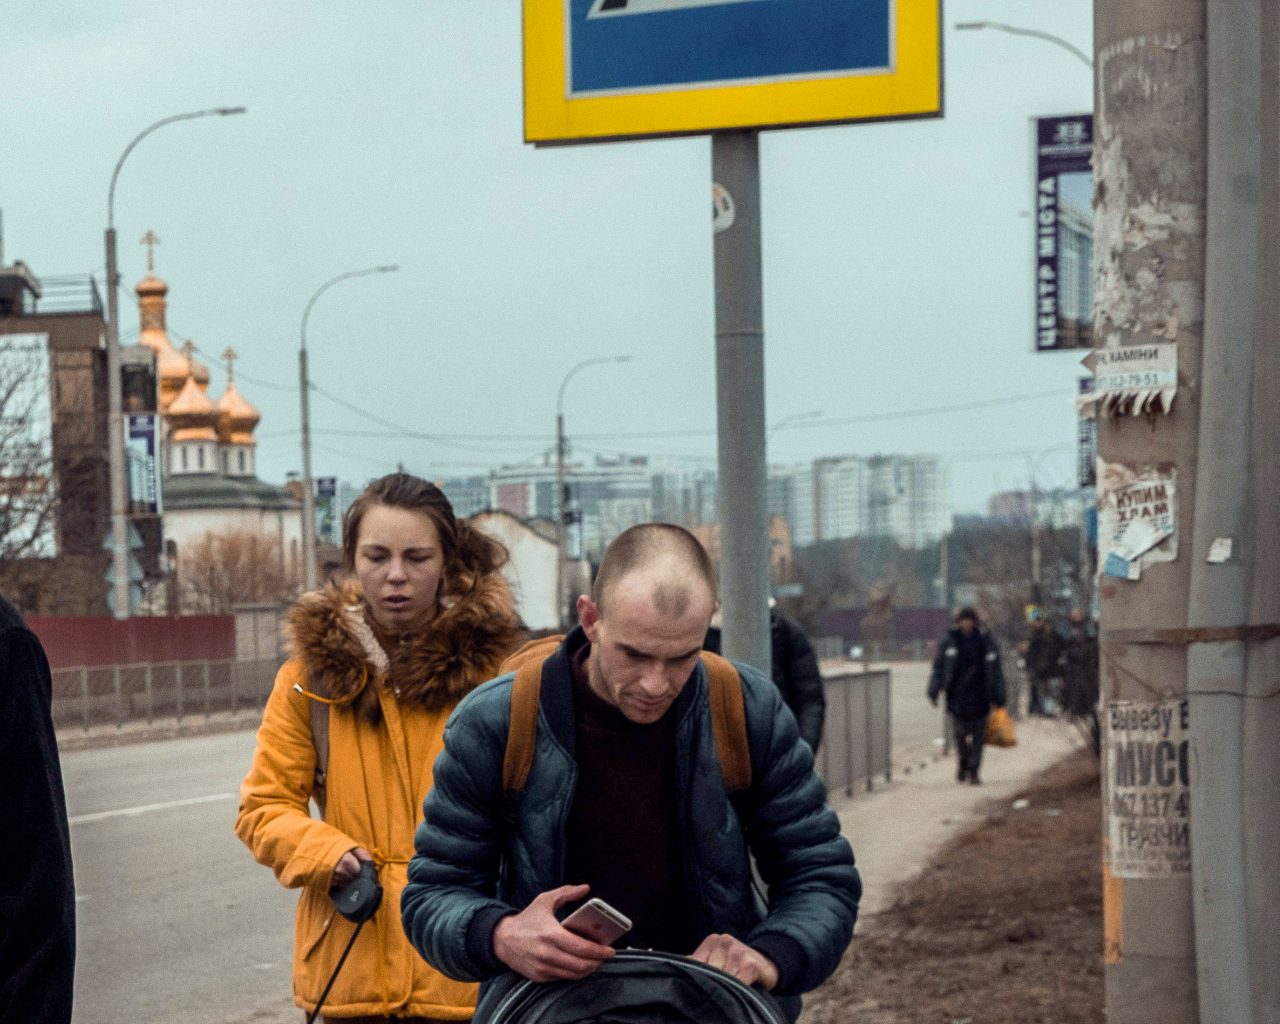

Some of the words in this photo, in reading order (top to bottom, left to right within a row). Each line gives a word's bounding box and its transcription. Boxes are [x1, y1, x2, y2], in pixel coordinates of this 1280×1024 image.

[1038, 176, 1057, 258] МІСТА
[1038, 264, 1057, 347] ЦЕНТР
[1116, 484, 1168, 509] КУПИМ
[1118, 502, 1169, 522] ХЛАМ
